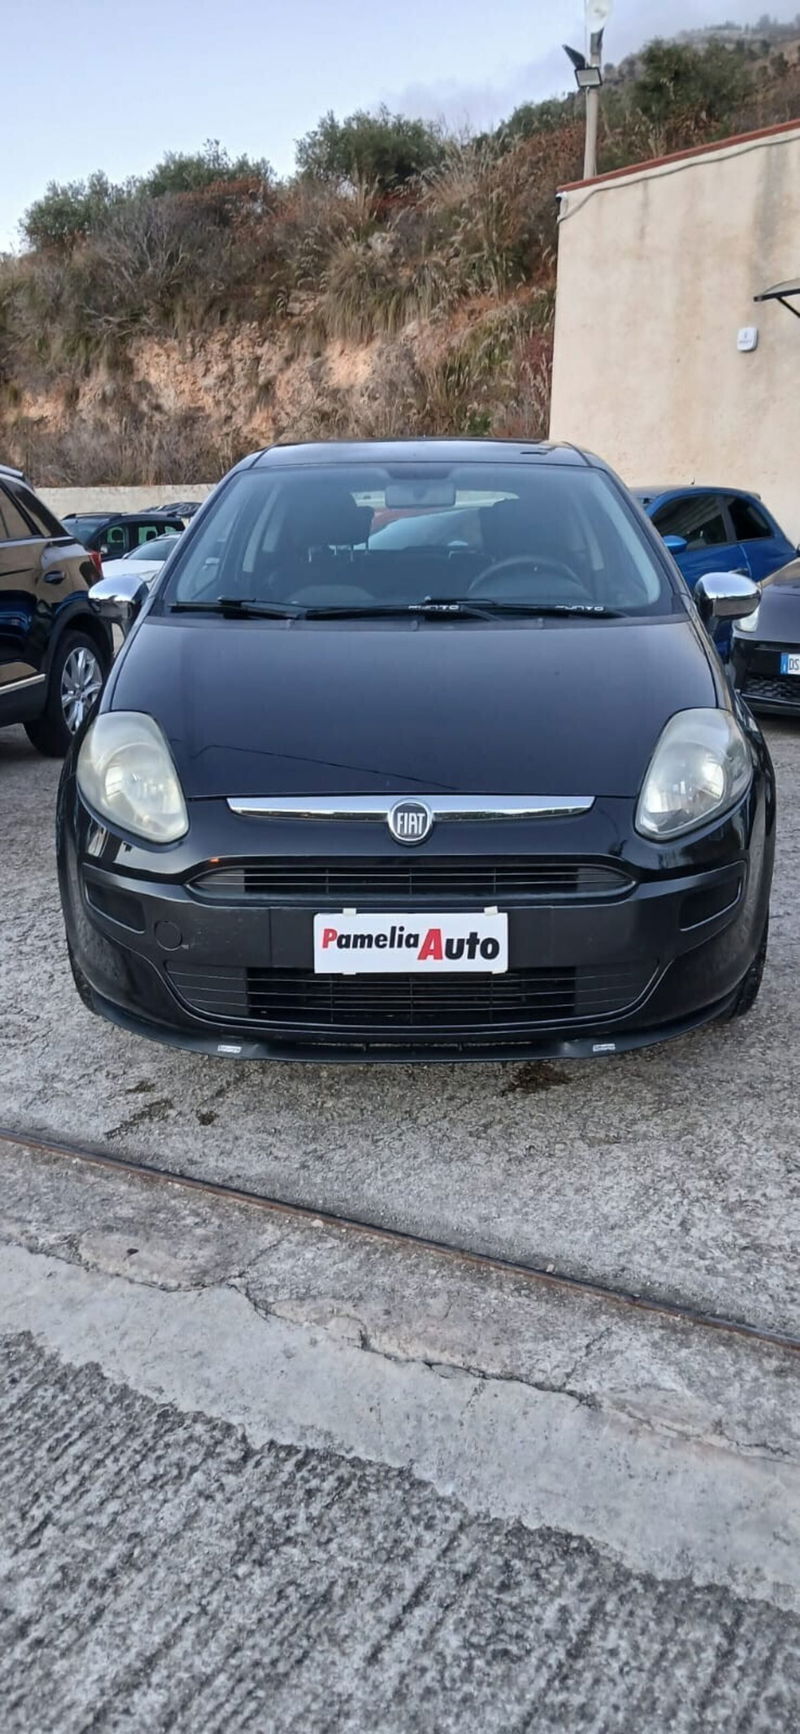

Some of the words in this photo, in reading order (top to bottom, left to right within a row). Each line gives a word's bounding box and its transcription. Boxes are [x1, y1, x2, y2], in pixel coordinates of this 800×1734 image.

[396, 812, 426, 835] FIAT
[322, 926, 420, 949] Pamelia
[417, 928, 500, 961] Auto
